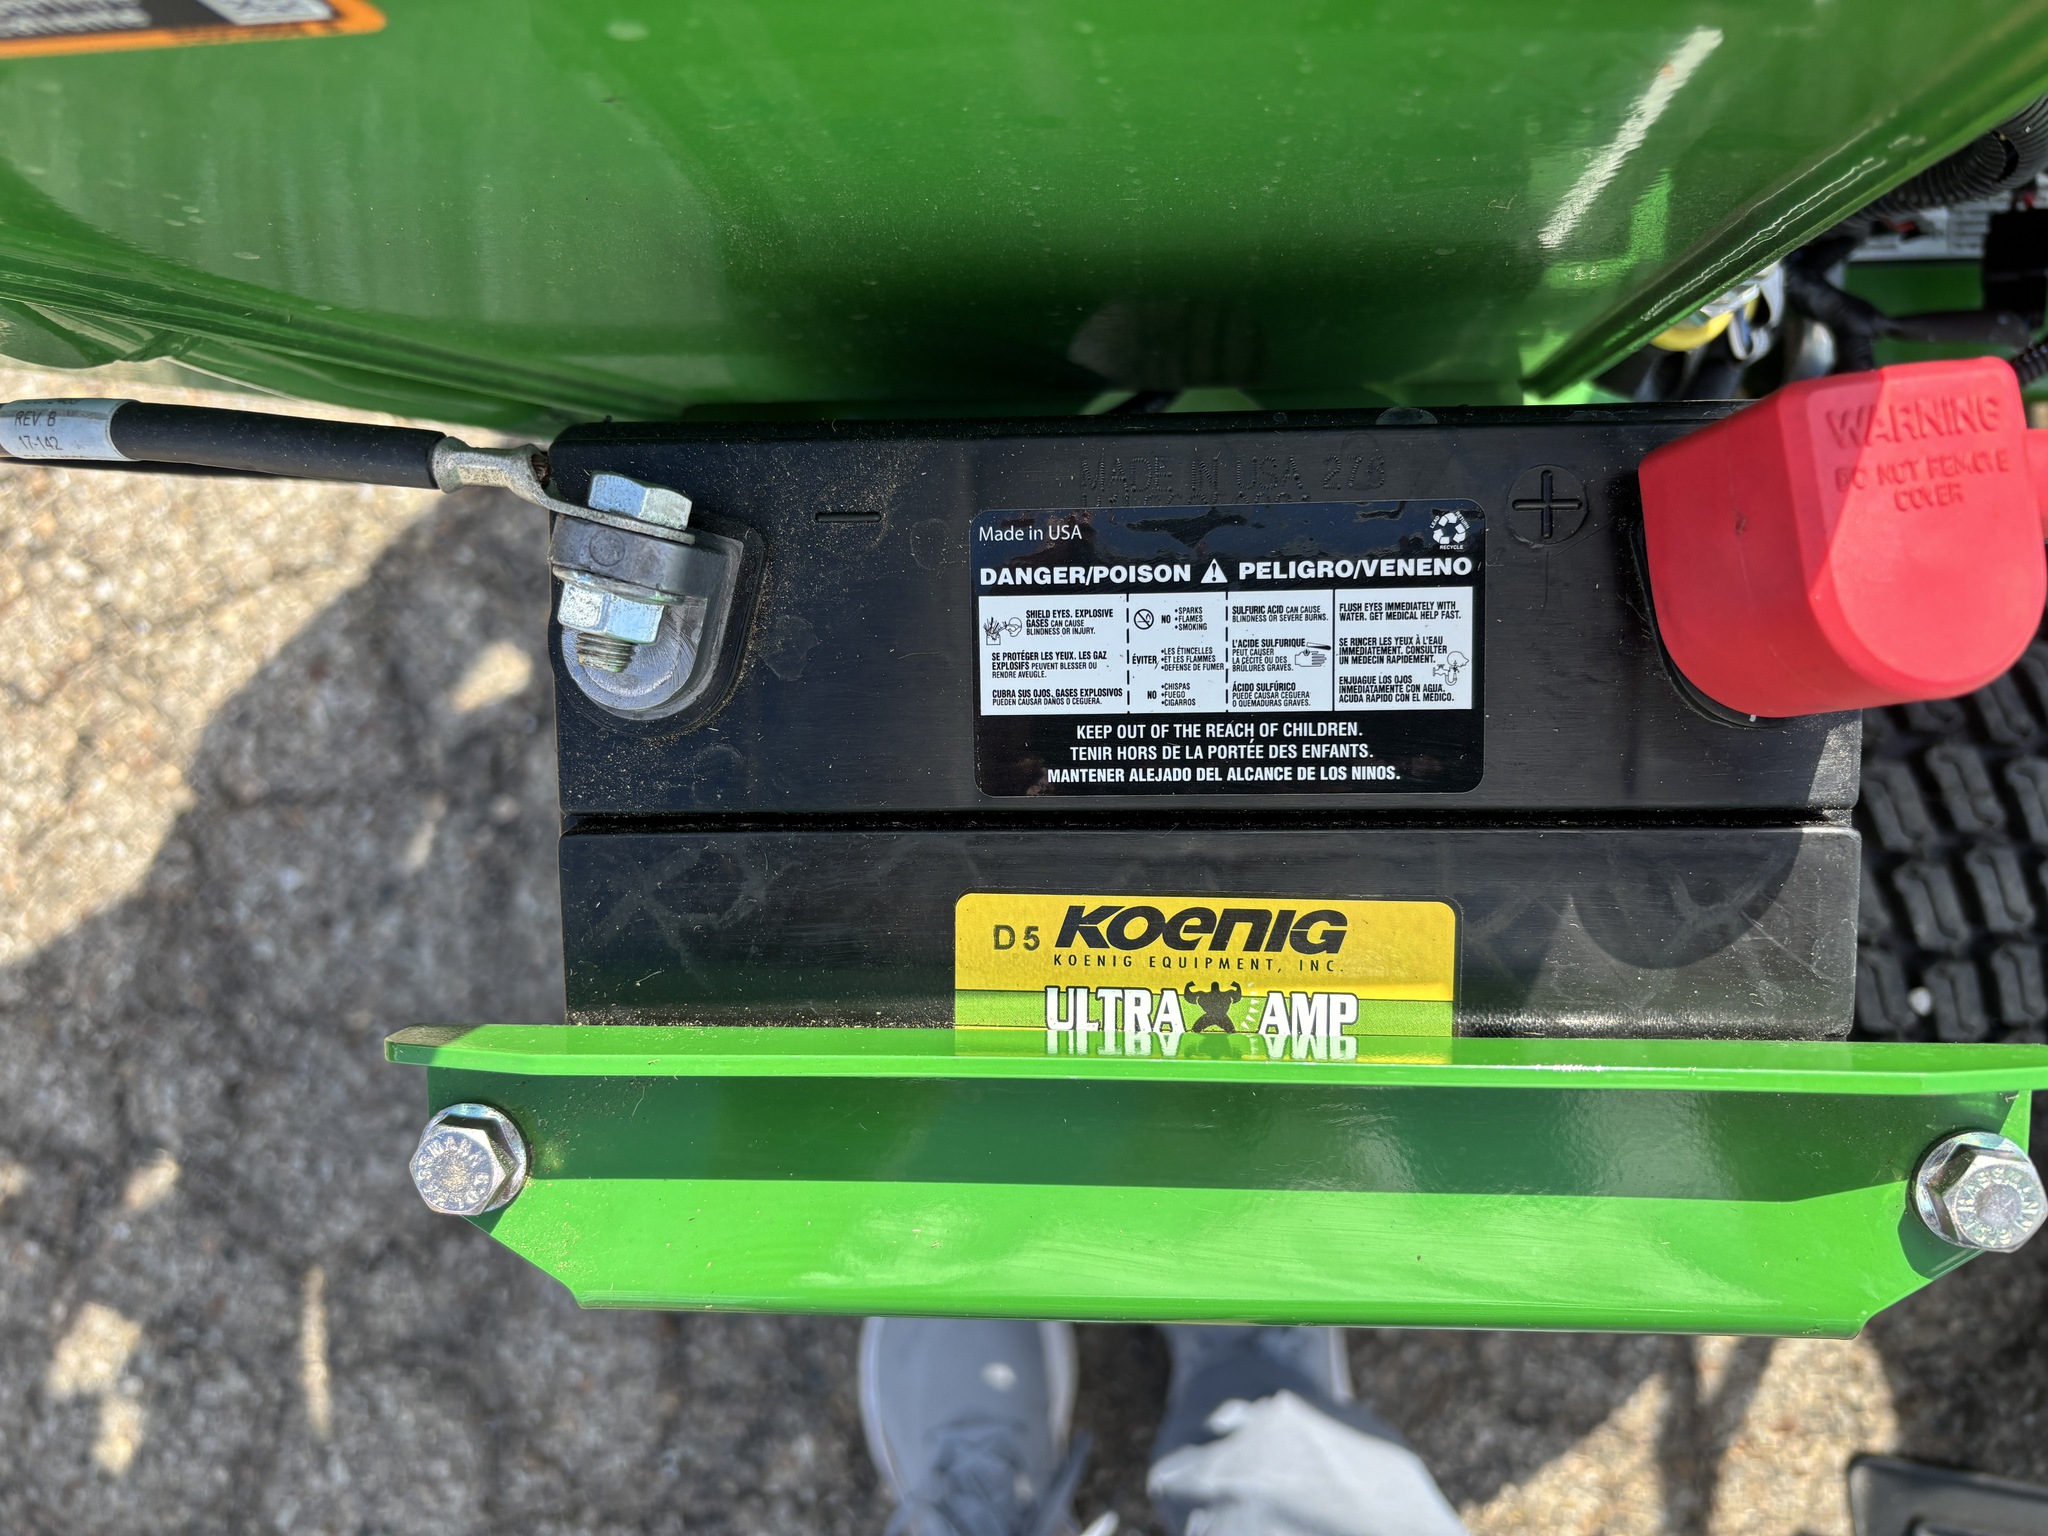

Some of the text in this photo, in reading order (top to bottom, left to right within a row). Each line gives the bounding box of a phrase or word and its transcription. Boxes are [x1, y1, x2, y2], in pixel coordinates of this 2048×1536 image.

[47, 411, 56, 427] B
[1825, 397, 1999, 450] WARNING
[18, 435, 63, 450] 17-142
[1081, 457, 1174, 492] MADE
[1236, 455, 1302, 490] USA
[979, 525, 1082, 541] Made in USA
[1238, 557, 1472, 580] PELIGRO/VENENO
[980, 564, 1191, 586] DANGER/POISON
[1232, 606, 1265, 614] SULFURIC
[1267, 605, 1283, 614] ACID
[1339, 601, 1456, 612] FLUSH EYES IMMEDIATELY WITH
[1026, 609, 1113, 618] SHIELD EYES. EXPLOSIVE
[1269, 614, 1277, 622] OR
[1279, 614, 1303, 622] SEVERE
[1305, 613, 1328, 621] BURNS.
[1339, 610, 1461, 621] WATER. GET MEDICAL HELP FAST.
[1026, 619, 1049, 628] GASES
[1161, 615, 1171, 624] NO
[1026, 628, 1060, 636] BLINDNESS
[1072, 627, 1096, 635] INJURY.
[1261, 638, 1305, 648] SULFURIQUE
[1339, 638, 1348, 646] SE
[1380, 637, 1392, 645] LES
[1394, 637, 1413, 645] YEUX
[1406, 645, 1447, 654] CONSULTER
[992, 653, 1000, 661] SE
[1040, 652, 1053, 660] LES
[1055, 652, 1076, 660] YEUX.
[1079, 651, 1091, 660] LES
[1093, 651, 1107, 659] GAZ
[1275, 656, 1287, 664] DES
[1339, 656, 1349, 665] UN
[1386, 655, 1435, 664] RAPIDEMENT.
[992, 662, 1029, 670] EXPLOSIFS
[1193, 663, 1201, 671] DE
[1339, 675, 1412, 685] ENJUAGUE LOS OJOS
[993, 688, 1123, 698] CUBRA SUS OJOS. GASES EXPLOSIVOS
[1339, 685, 1403, 694] INMEDIATAMENTE
[1406, 684, 1420, 692] CON
[1147, 691, 1157, 699] NO
[1232, 692, 1252, 700] PUEDE
[1281, 691, 1310, 699] CEGUERA
[1339, 694, 1364, 703] ACUDA
[1395, 694, 1410, 702] CON
[1412, 693, 1421, 702] EL
[993, 698, 1016, 706] PUEDEN
[1239, 699, 1282, 707] QUEMADURAS
[1077, 722, 1363, 739] KEEP OUT OF THE REACH OF CHILDREN.
[1070, 739, 1374, 761] TENIR HORS DE LA PORTÉE DES ENFANTS.
[1048, 766, 1401, 783] MANTENER ALEJADO DEL ALCANCE DE LOS NINOS.
[1054, 954, 1345, 974] KOENIG EQUIPMENT, INC.
[1044, 986, 1359, 1036] ULTRA AMP
